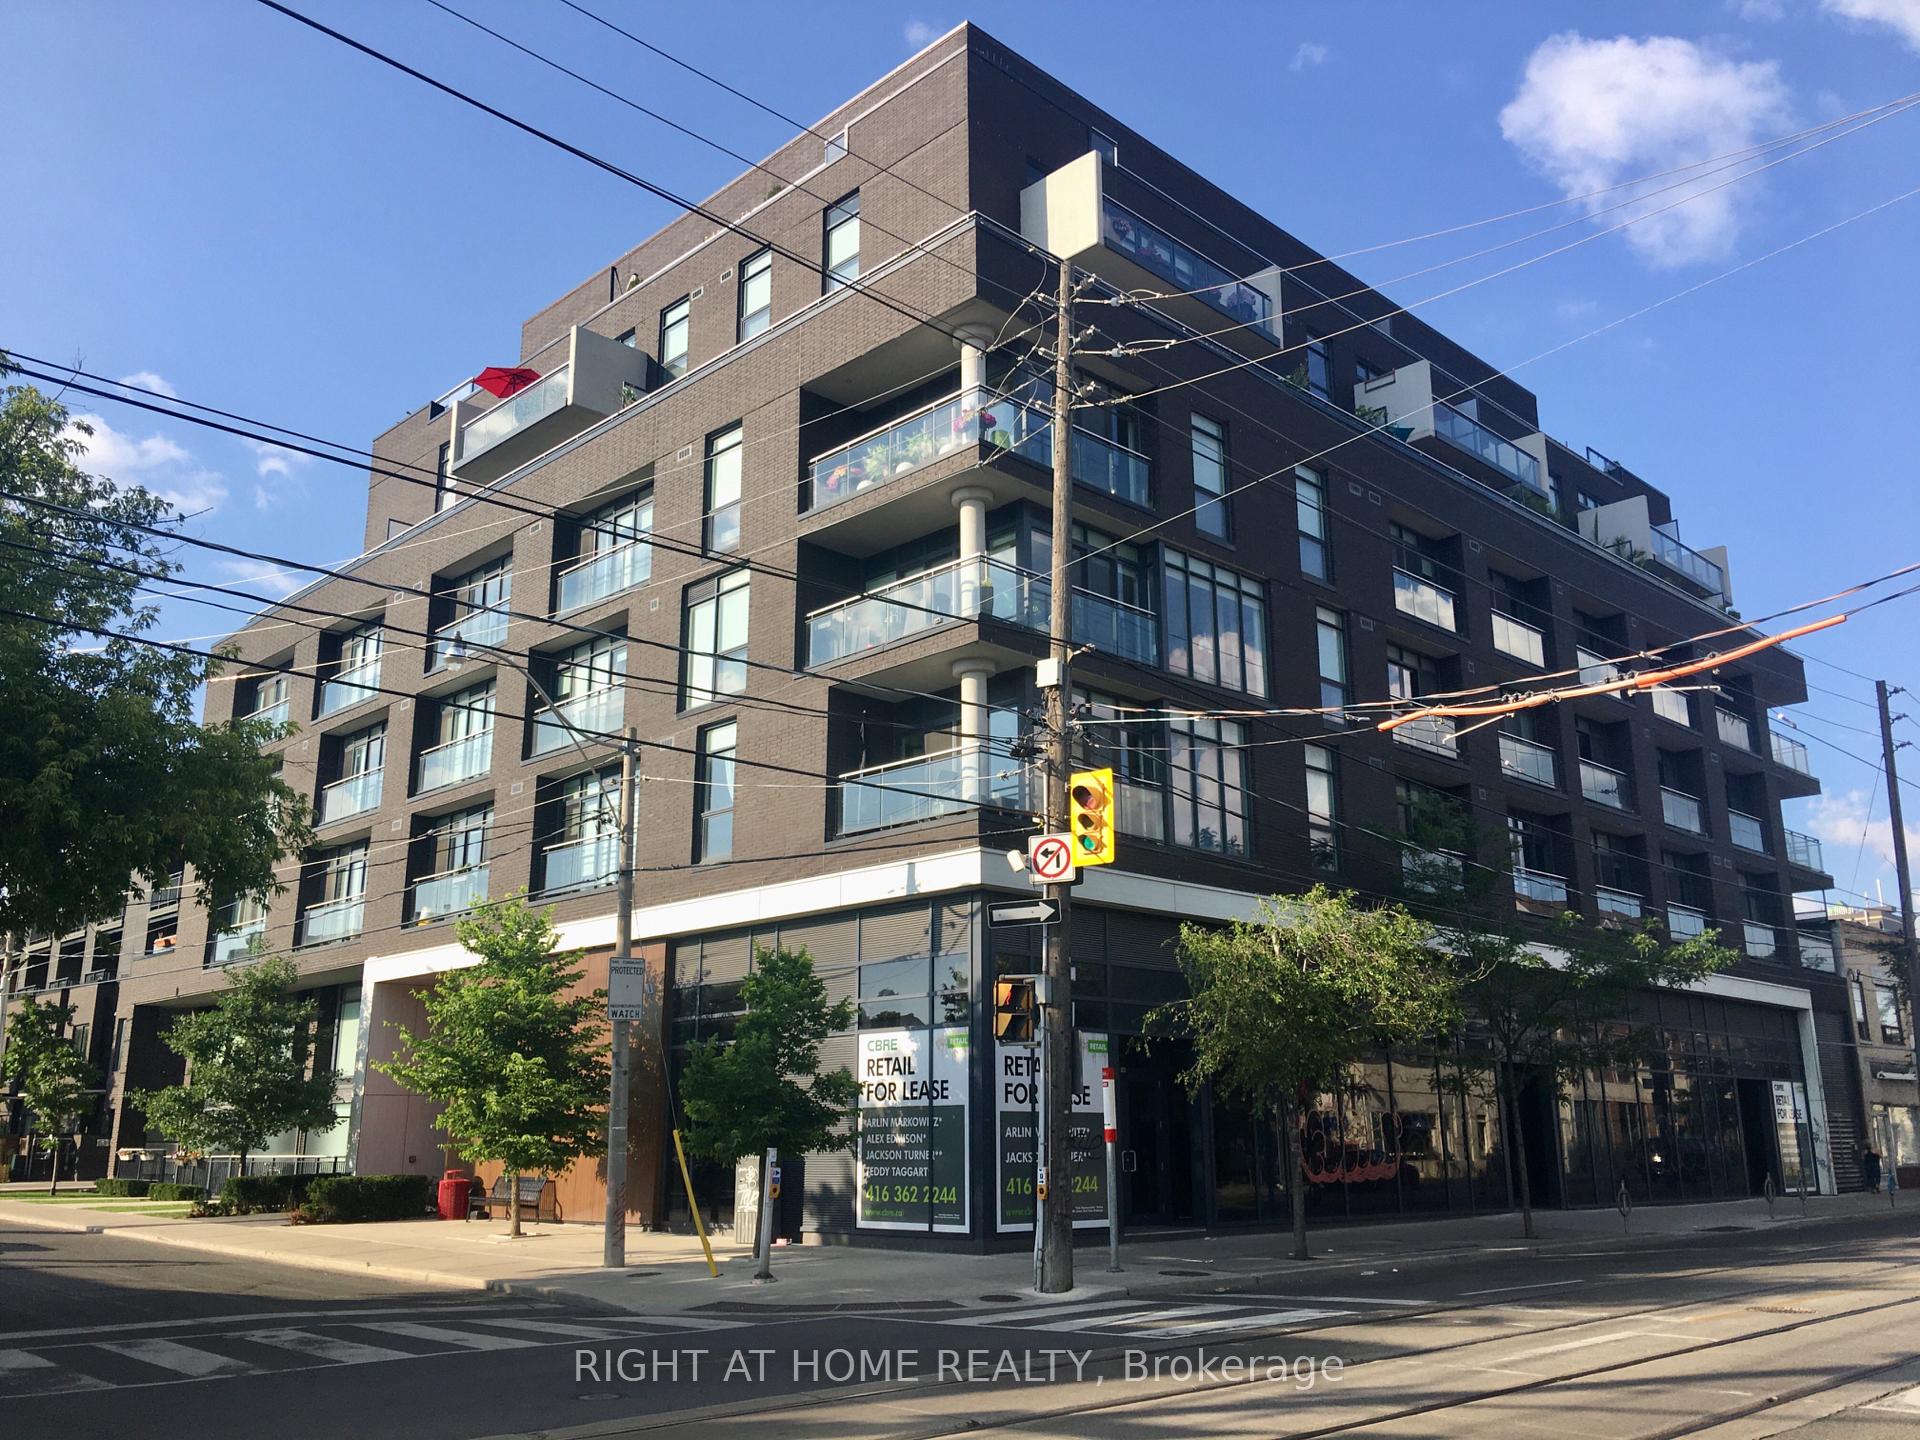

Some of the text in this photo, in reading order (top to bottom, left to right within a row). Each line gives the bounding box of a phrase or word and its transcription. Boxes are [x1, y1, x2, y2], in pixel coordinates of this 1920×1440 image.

[611, 966, 644, 975] PROTECTED
[611, 1009, 640, 1018] WATCH
[867, 1039, 898, 1052] CBRE
[1089, 1043, 1107, 1051] RETAIL
[867, 1056, 915, 1076] RETAIL
[1004, 1055, 1040, 1076] RETA
[866, 1080, 949, 1102] FOR LEASE
[1004, 1083, 1038, 1104] FOR
[866, 1118, 889, 1128] ARLIN
[1005, 1127, 1032, 1138] ARLIN
[866, 1134, 885, 1144] ALEX
[866, 1150, 902, 1160] JACKSON
[866, 1166, 928, 1177] TEDDY TAGGART
[1006, 1176, 1098, 1195] 416 244
[866, 1185, 957, 1204] 416 362 2244
